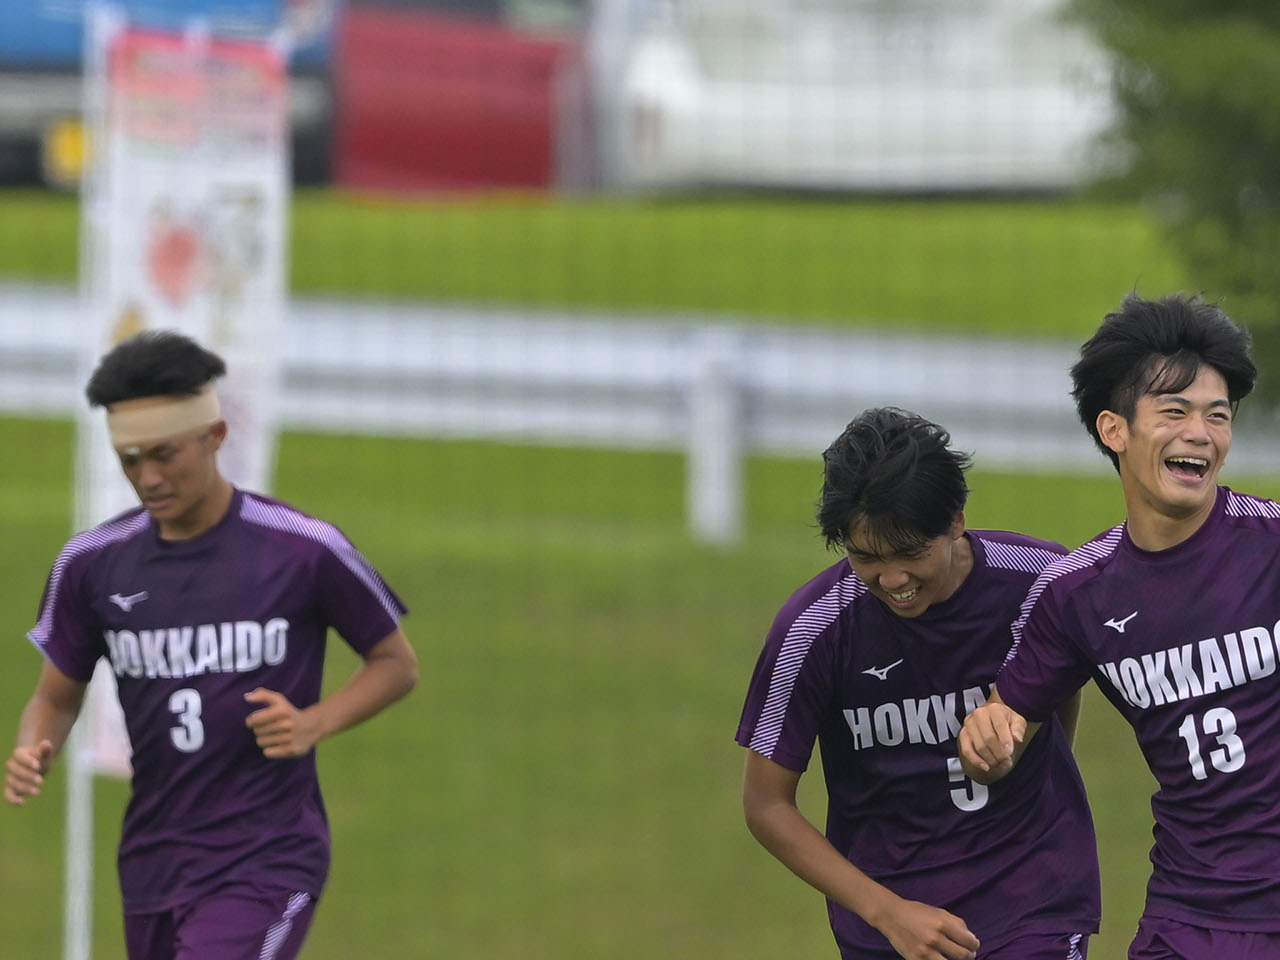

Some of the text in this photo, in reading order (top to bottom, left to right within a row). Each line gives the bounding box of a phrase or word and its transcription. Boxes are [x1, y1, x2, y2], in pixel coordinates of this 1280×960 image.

[168, 687, 204, 753] 3
[1178, 707, 1246, 780] 13
[947, 757, 989, 812] 5
